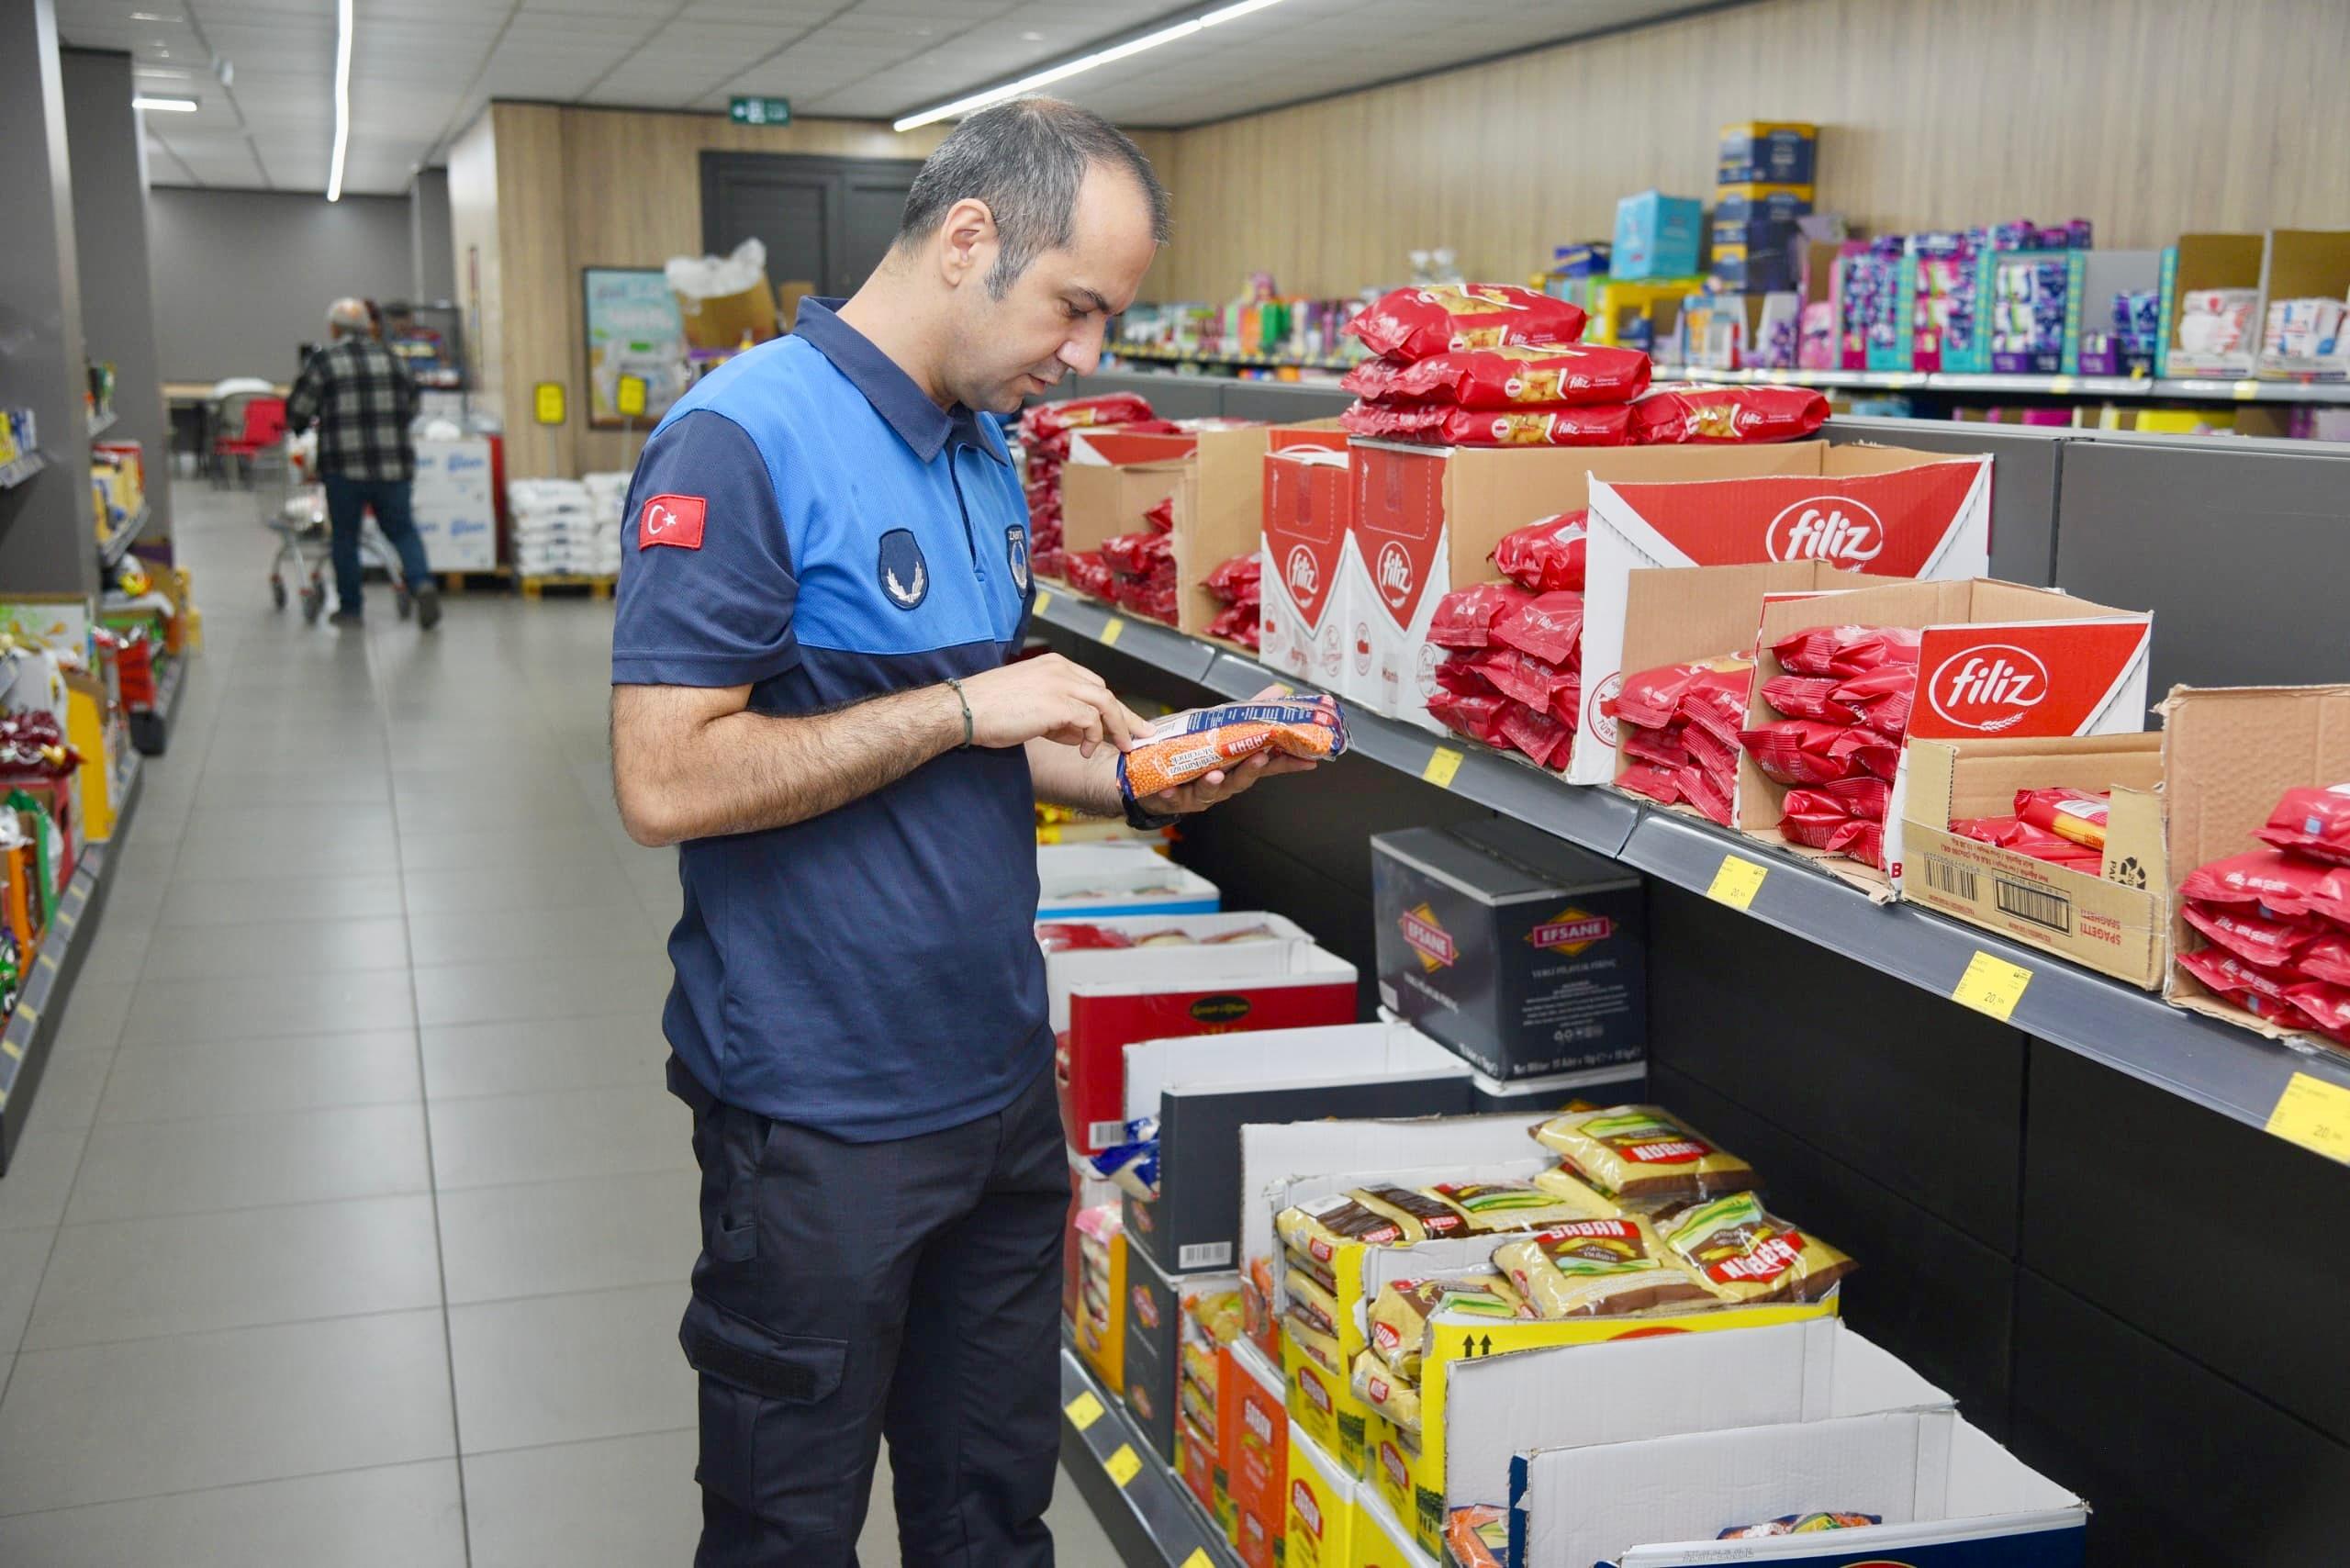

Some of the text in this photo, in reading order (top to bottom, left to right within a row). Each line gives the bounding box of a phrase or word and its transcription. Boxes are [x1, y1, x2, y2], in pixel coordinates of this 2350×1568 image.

[1785, 509, 1883, 561] filiz
[1292, 553, 1319, 595] filiz
[1382, 549, 1413, 595] filiz
[1946, 658, 2047, 708] filiz
[1406, 919, 1448, 958] EFSANE
[1541, 921, 1603, 943] EFSANE
[2080, 923, 2121, 946] SPAGETTI
[1550, 1220, 1626, 1239] SABAN
